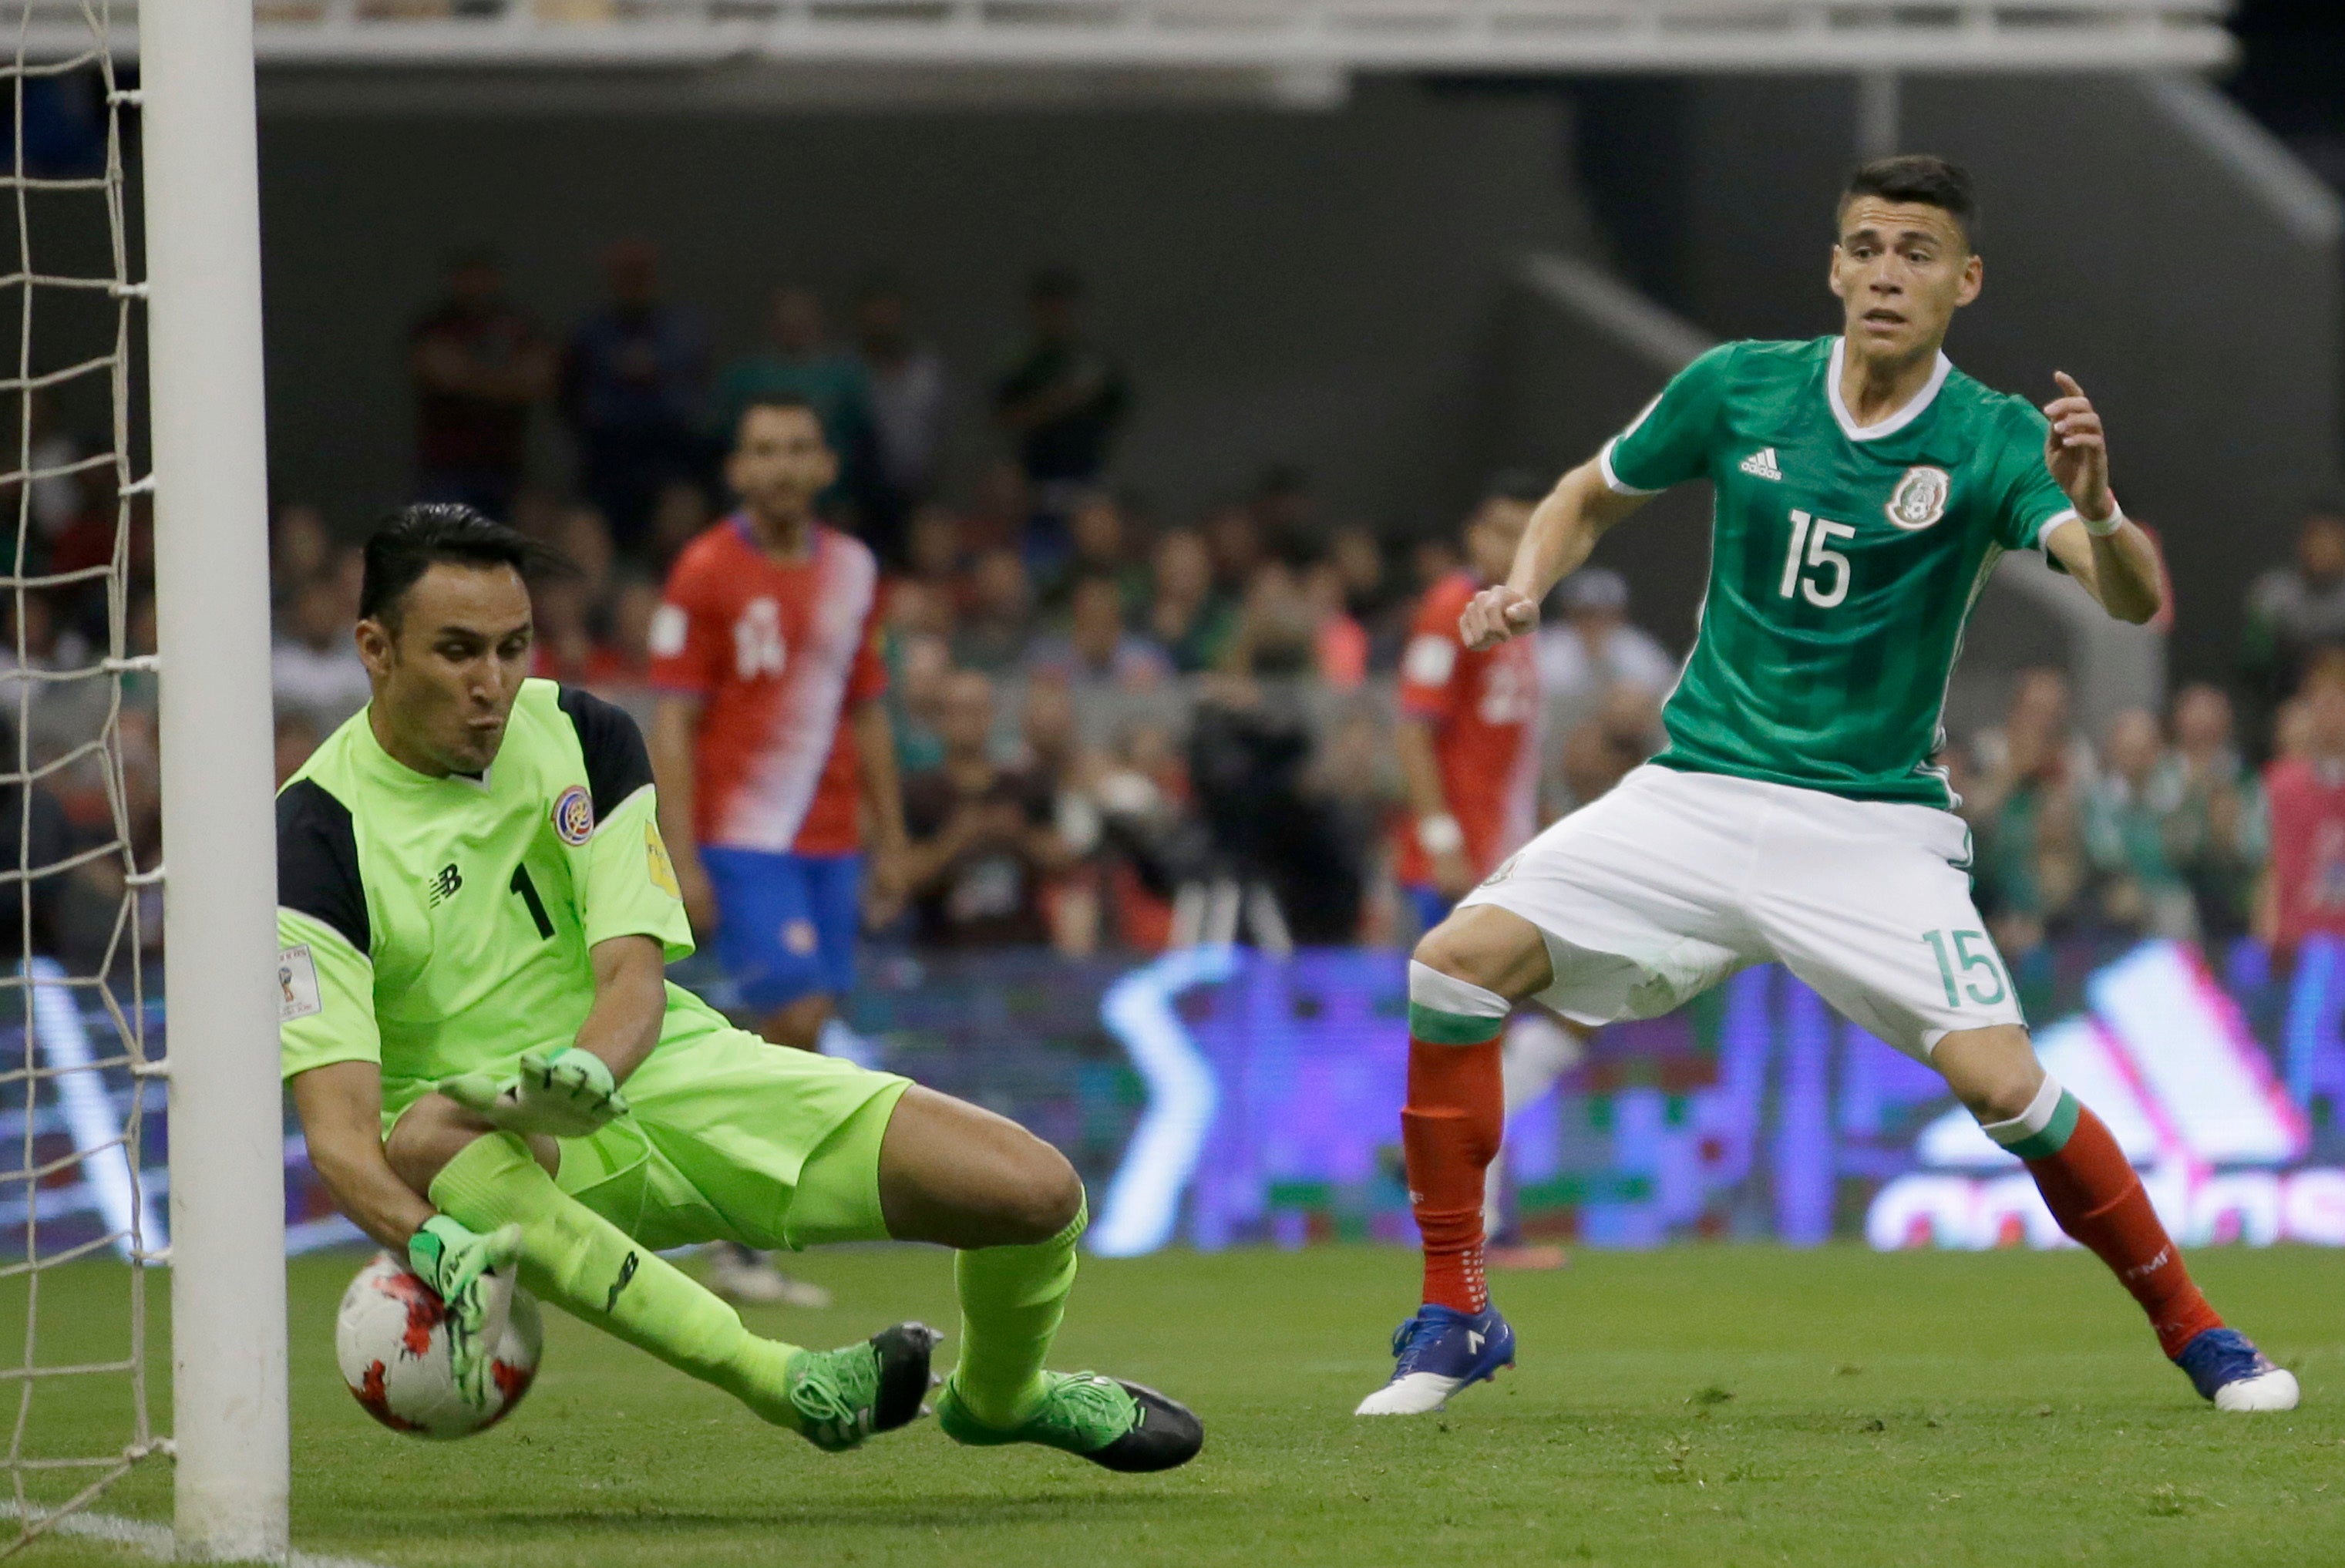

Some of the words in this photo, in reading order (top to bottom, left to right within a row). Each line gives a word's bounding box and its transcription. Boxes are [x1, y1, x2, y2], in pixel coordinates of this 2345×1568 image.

[1740, 461, 1782, 480] adidas
[1780, 509, 1856, 608] 15
[510, 862, 556, 940] 1
[1923, 929, 2005, 1008] 15
